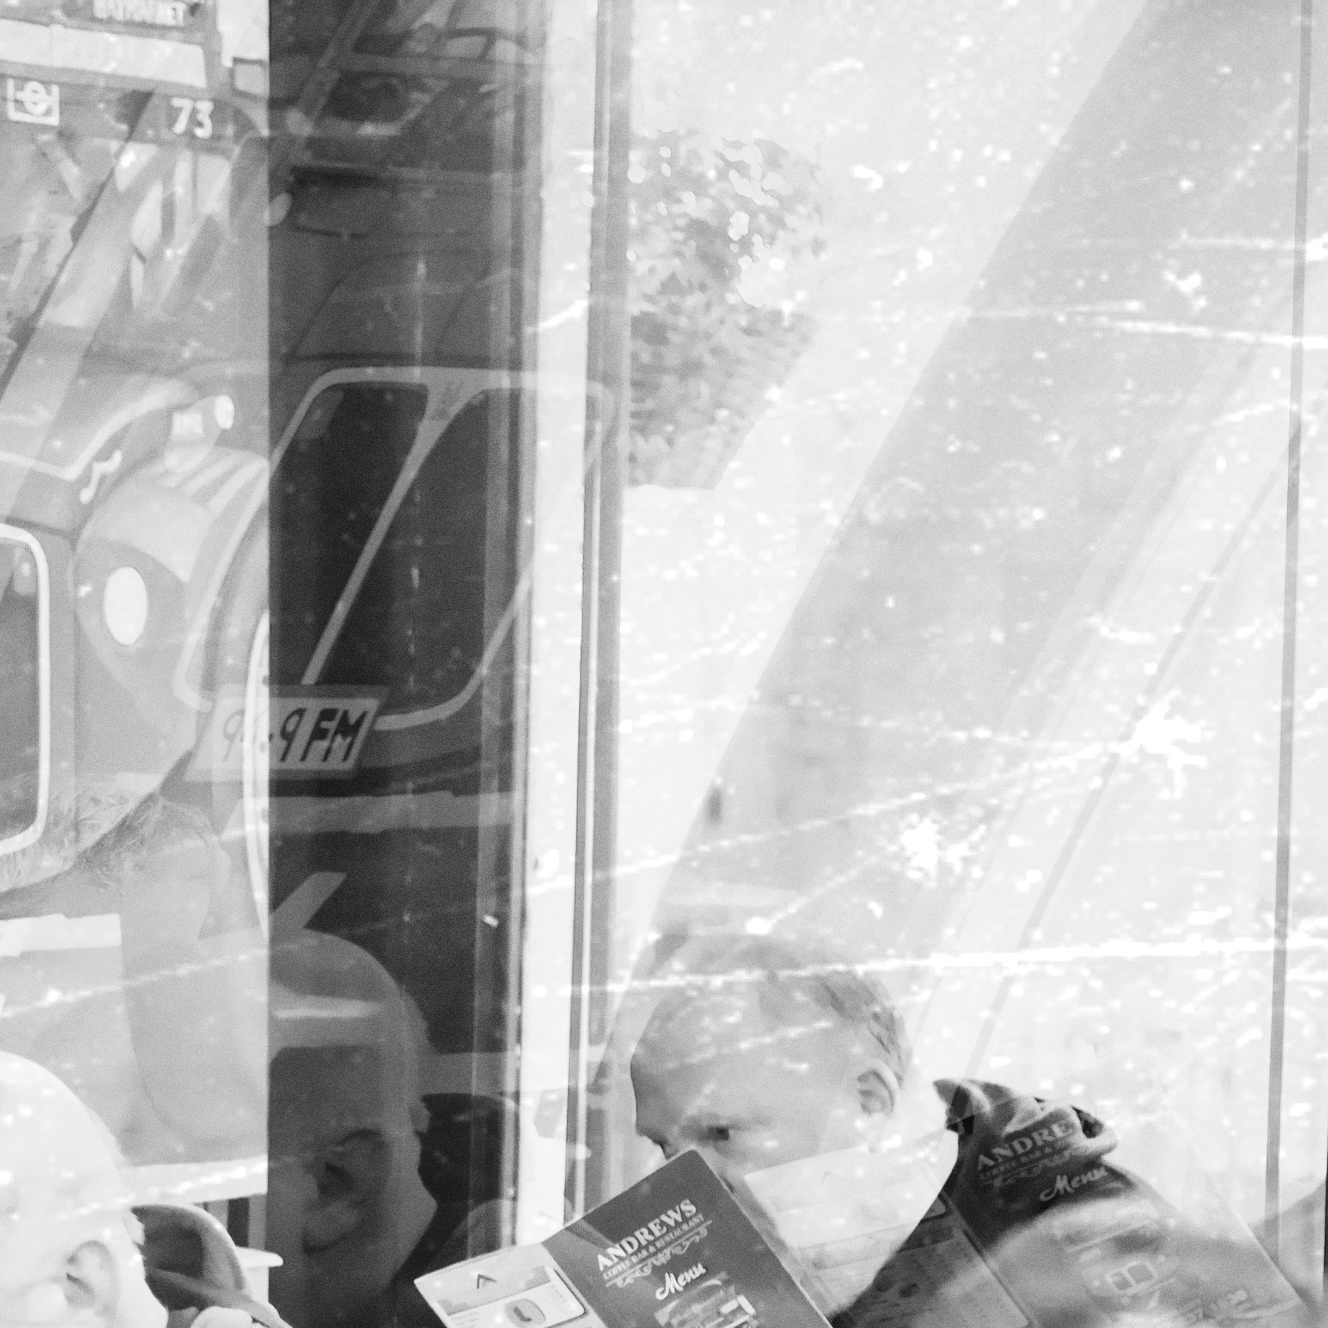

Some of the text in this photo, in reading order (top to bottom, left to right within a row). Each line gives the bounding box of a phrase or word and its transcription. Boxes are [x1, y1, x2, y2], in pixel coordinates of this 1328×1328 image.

[171, 97, 215, 139] 73
[300, 708, 368, 763] FM
[597, 1199, 697, 1272] ANDREWS
[655, 1262, 708, 1301] Menu
